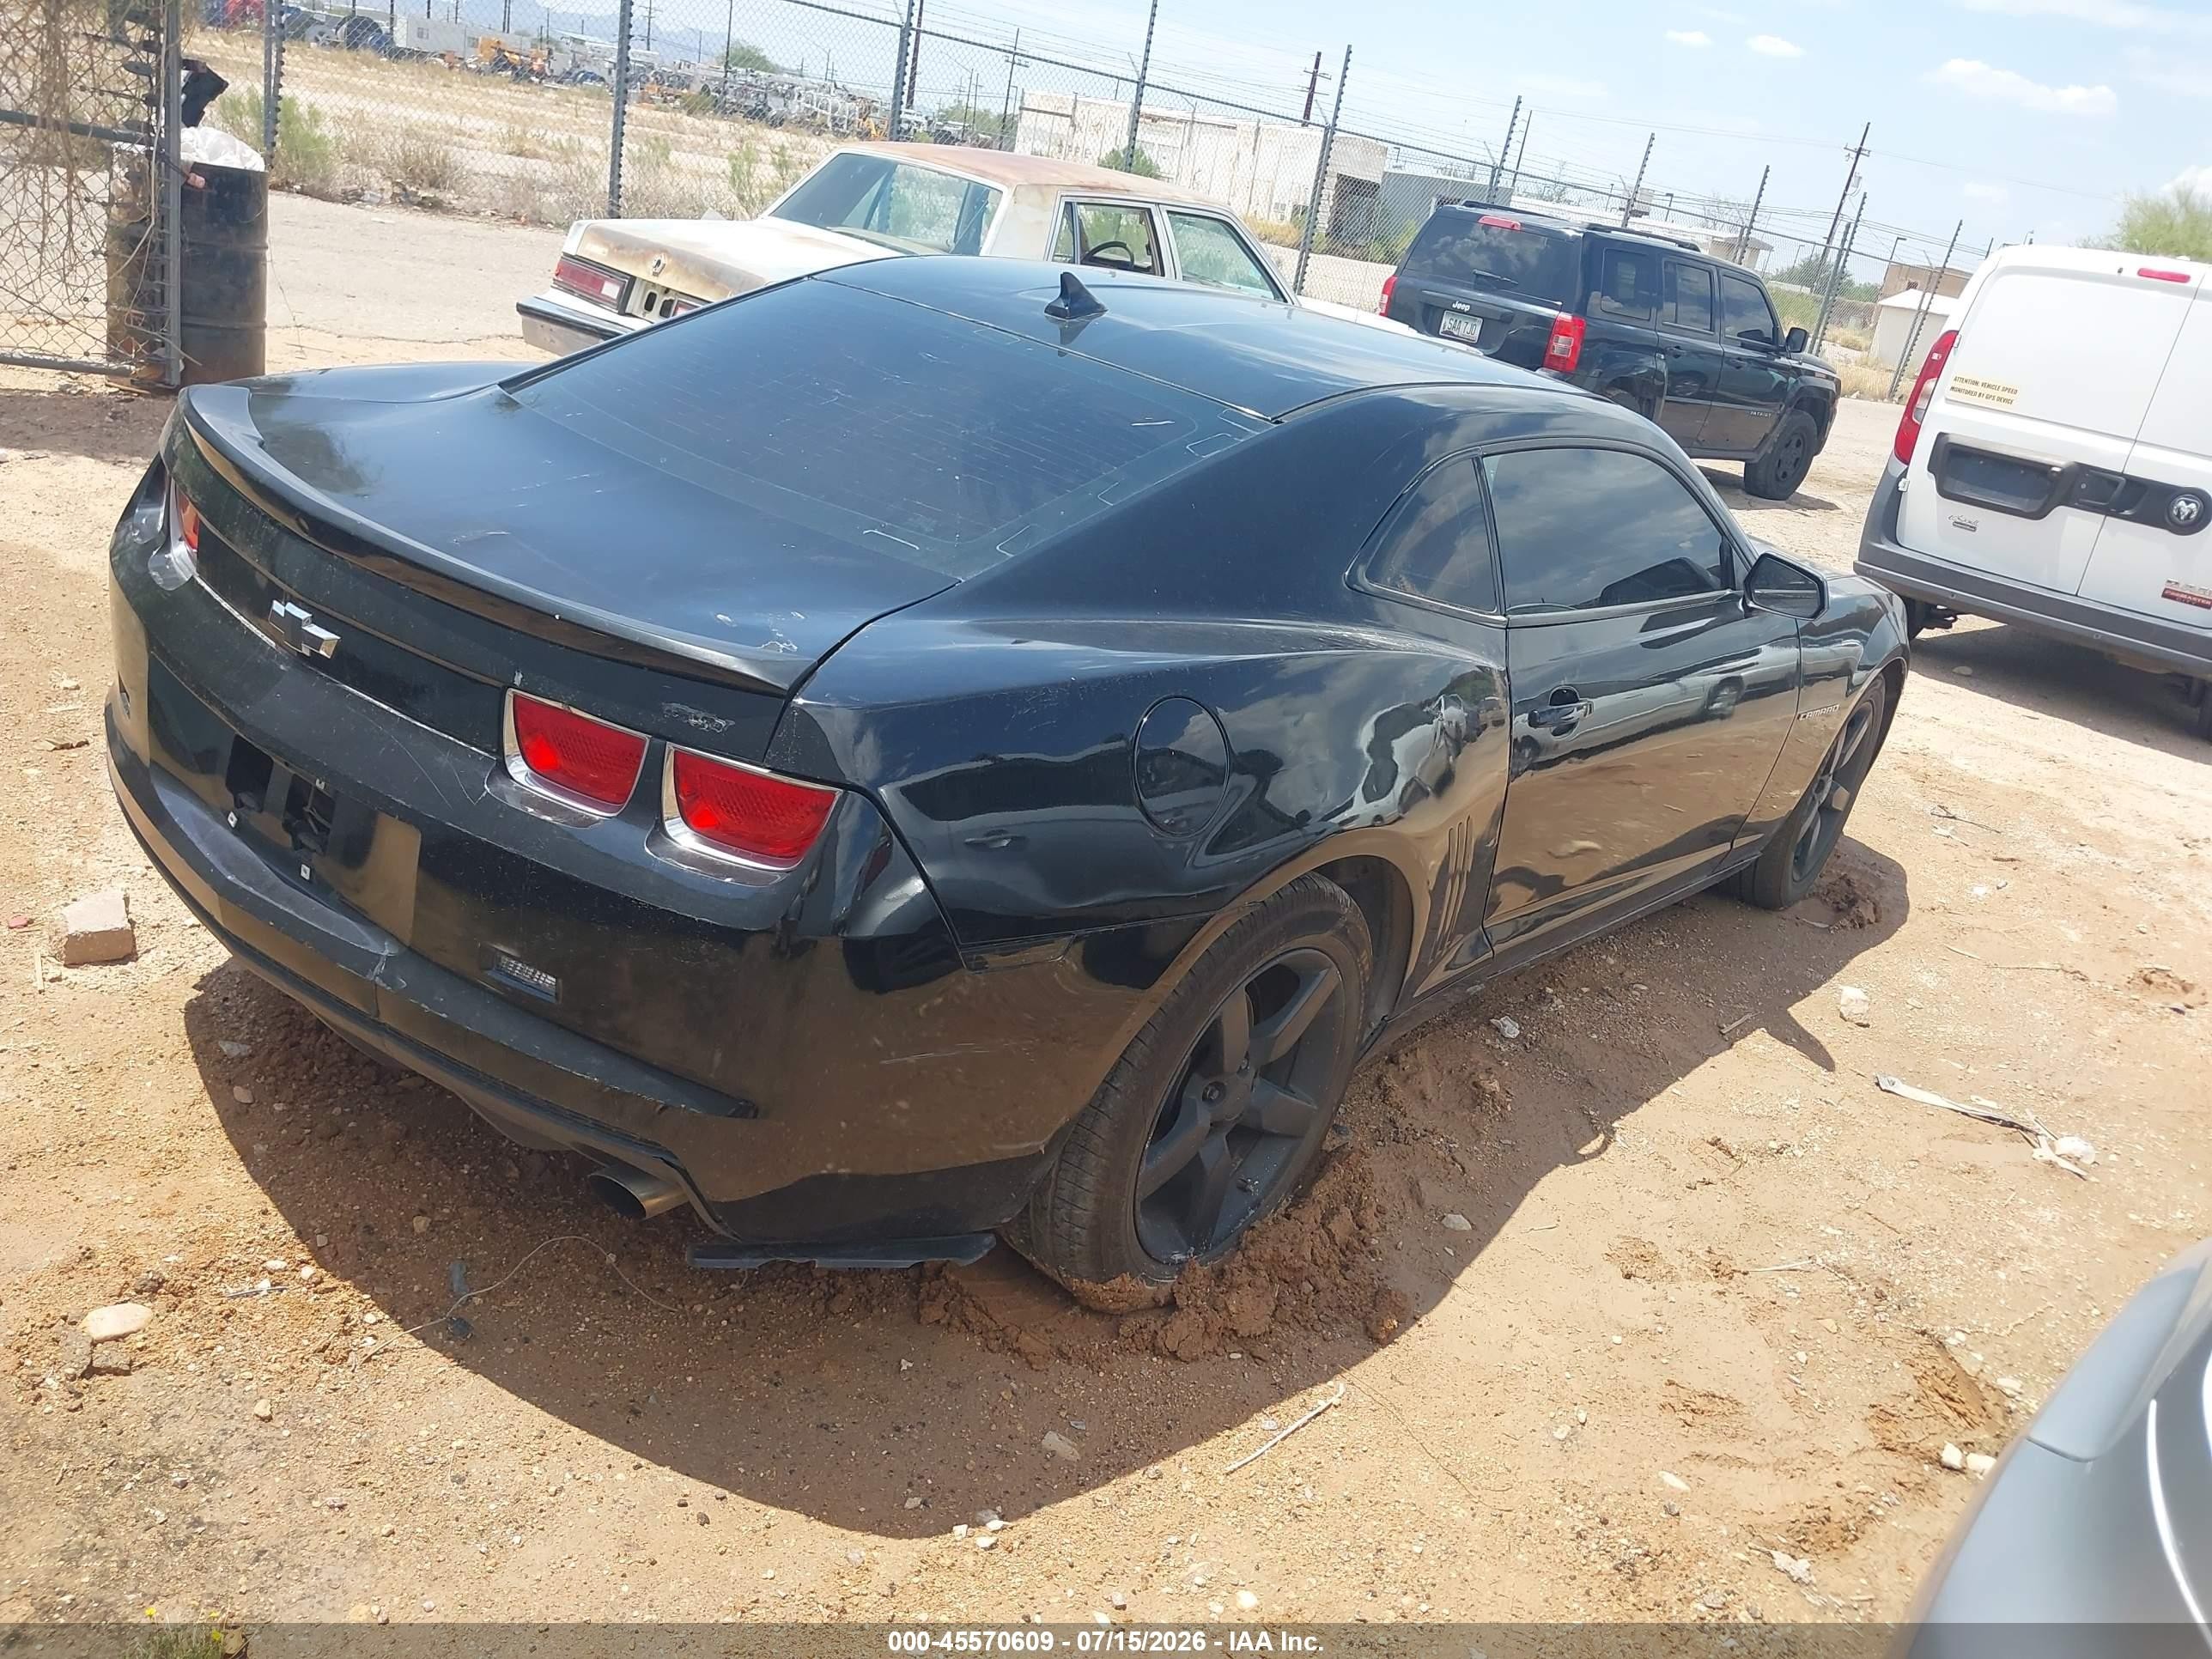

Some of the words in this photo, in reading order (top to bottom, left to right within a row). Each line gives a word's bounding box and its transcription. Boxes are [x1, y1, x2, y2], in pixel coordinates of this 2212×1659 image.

[1452, 301, 1470, 312] Jeep
[1950, 386, 1978, 396] MONITORED
[1996, 396, 2014, 405] DEVICE
[1981, 381, 2001, 392] VEHICLE
[2002, 386, 2018, 395] SPEED
[1798, 702, 1840, 721] CAMARO
